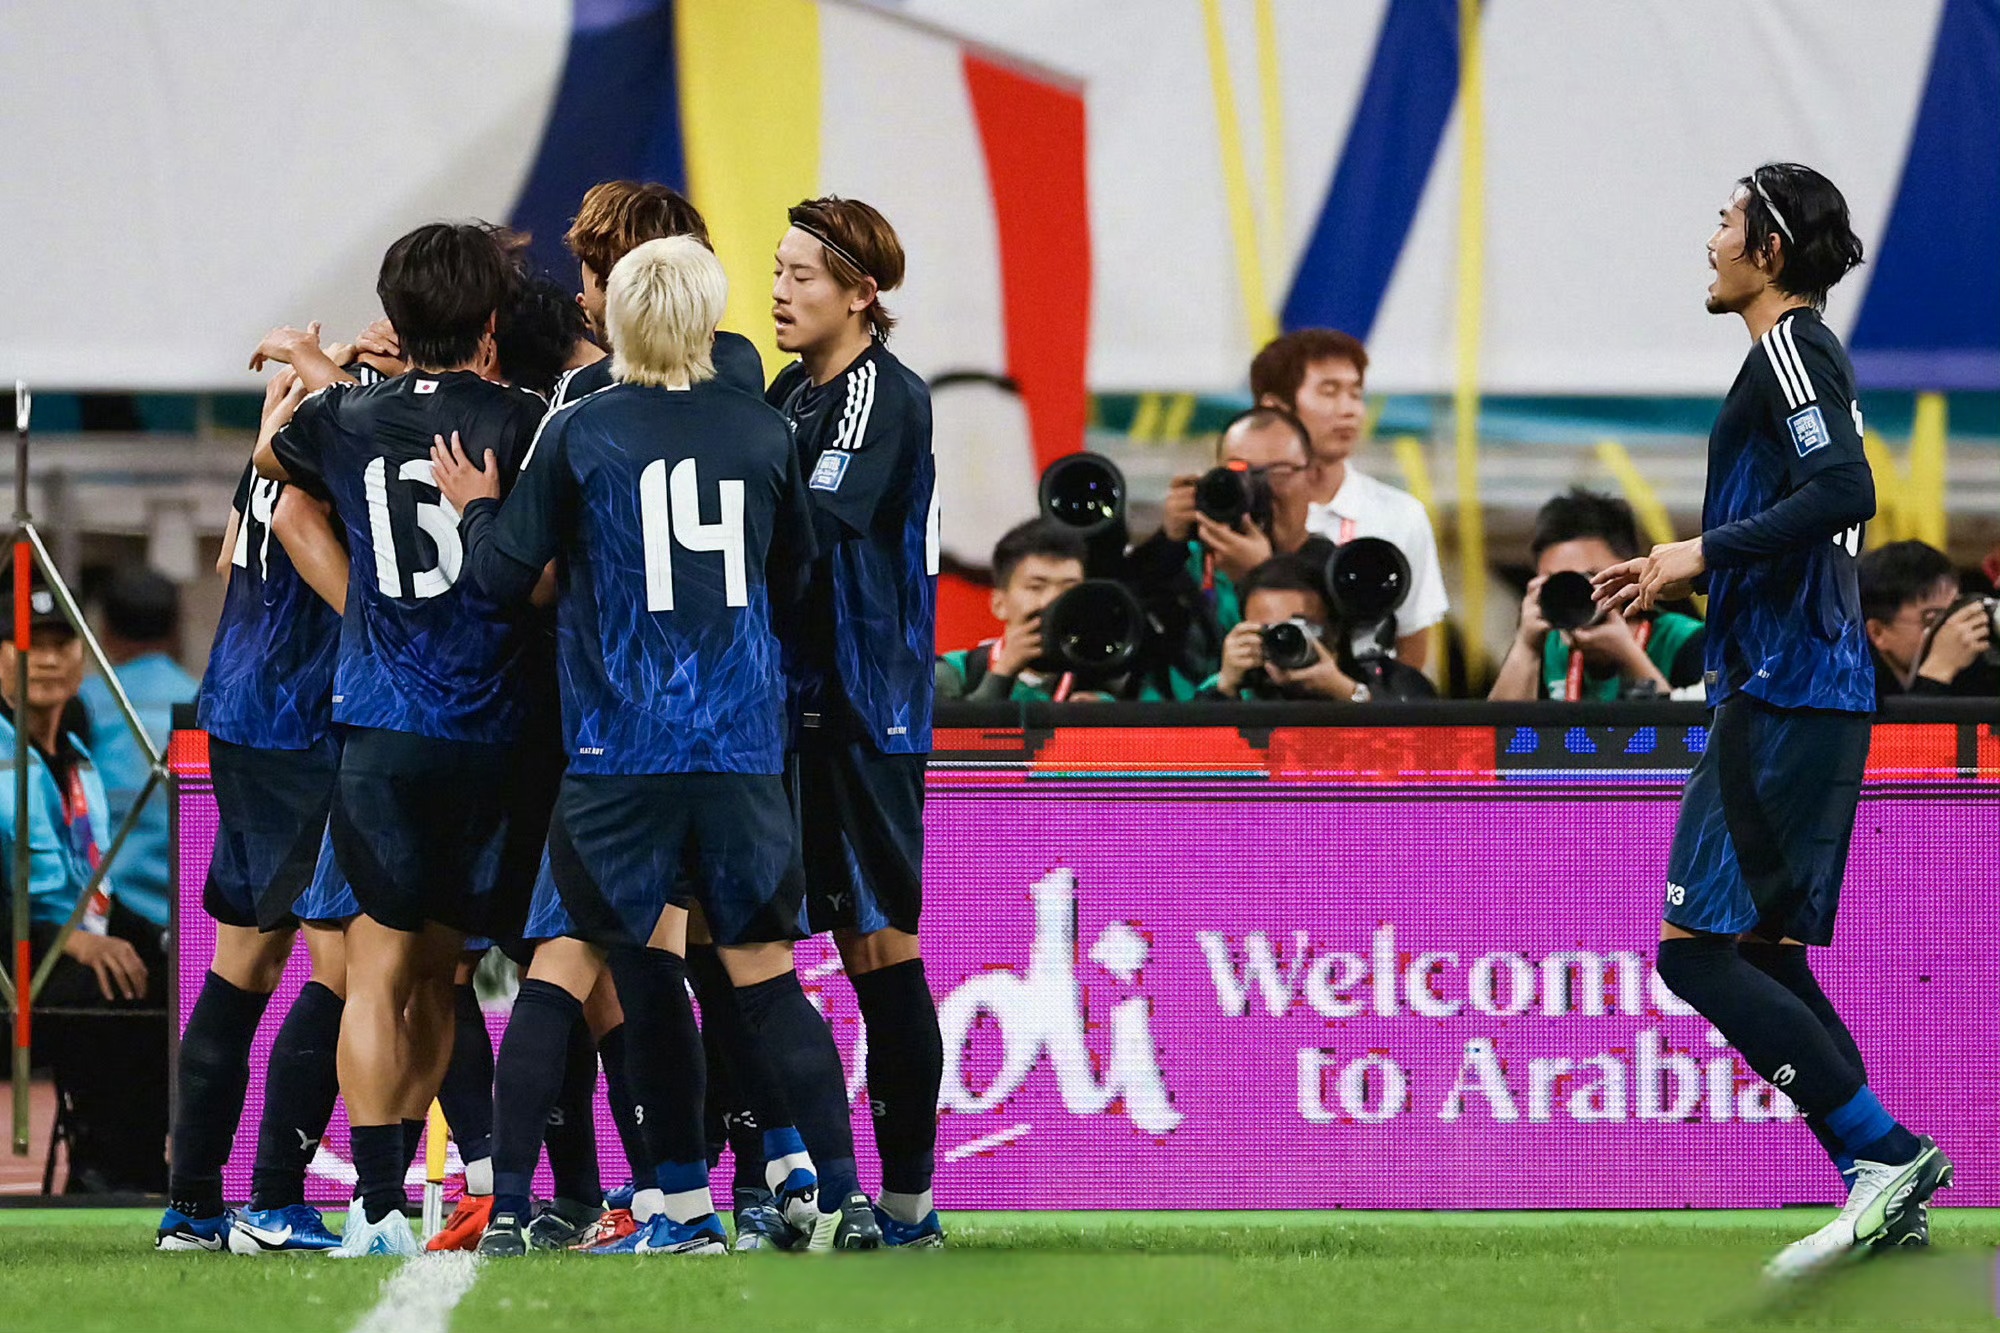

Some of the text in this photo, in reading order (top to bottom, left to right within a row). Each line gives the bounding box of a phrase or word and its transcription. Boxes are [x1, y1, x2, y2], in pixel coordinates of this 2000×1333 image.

[363, 455, 464, 599] 13
[639, 457, 749, 613] 14
[1296, 1028, 1804, 1124] to Arabia
